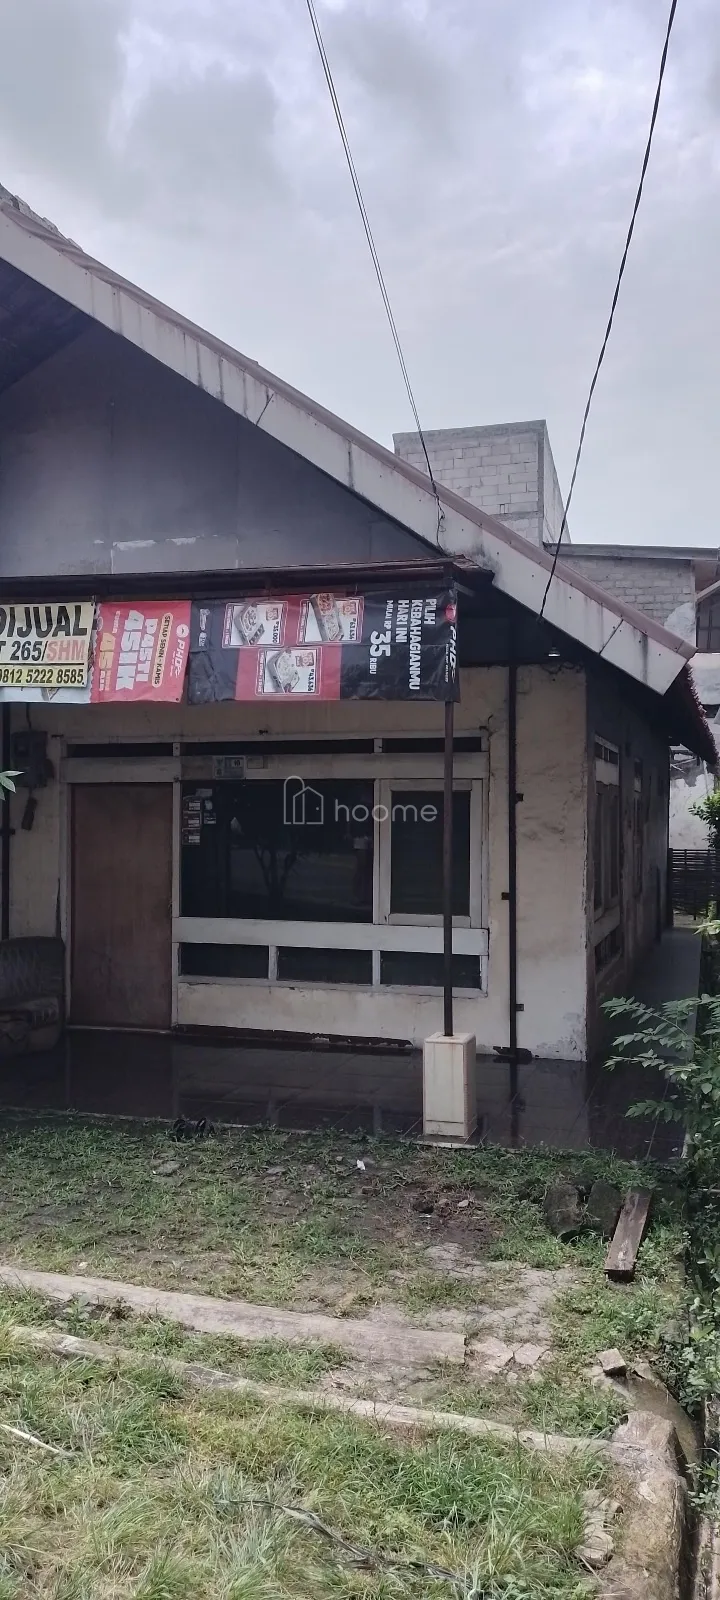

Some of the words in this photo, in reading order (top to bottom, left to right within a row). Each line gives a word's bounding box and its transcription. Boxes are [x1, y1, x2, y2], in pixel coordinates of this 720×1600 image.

[384, 600, 394, 619] MULAI
[397, 600, 409, 625] HARI
[424, 598, 437, 625] PILIH
[162, 615, 171, 637] SETIAP
[396, 628, 408, 642] INI
[10, 640, 85, 661] 265/SHM
[98, 633, 116, 669] 45
[115, 610, 145, 690] ASIK
[135, 619, 158, 682] PASTI
[158, 639, 167, 658] SENIN
[175, 639, 186, 668] PHD
[370, 631, 391, 657] 35
[409, 599, 423, 690] KEBAHAGIANMU
[25, 668, 53, 683] 5222
[56, 668, 84, 684] 8585
[154, 663, 163, 685] KAMIS
